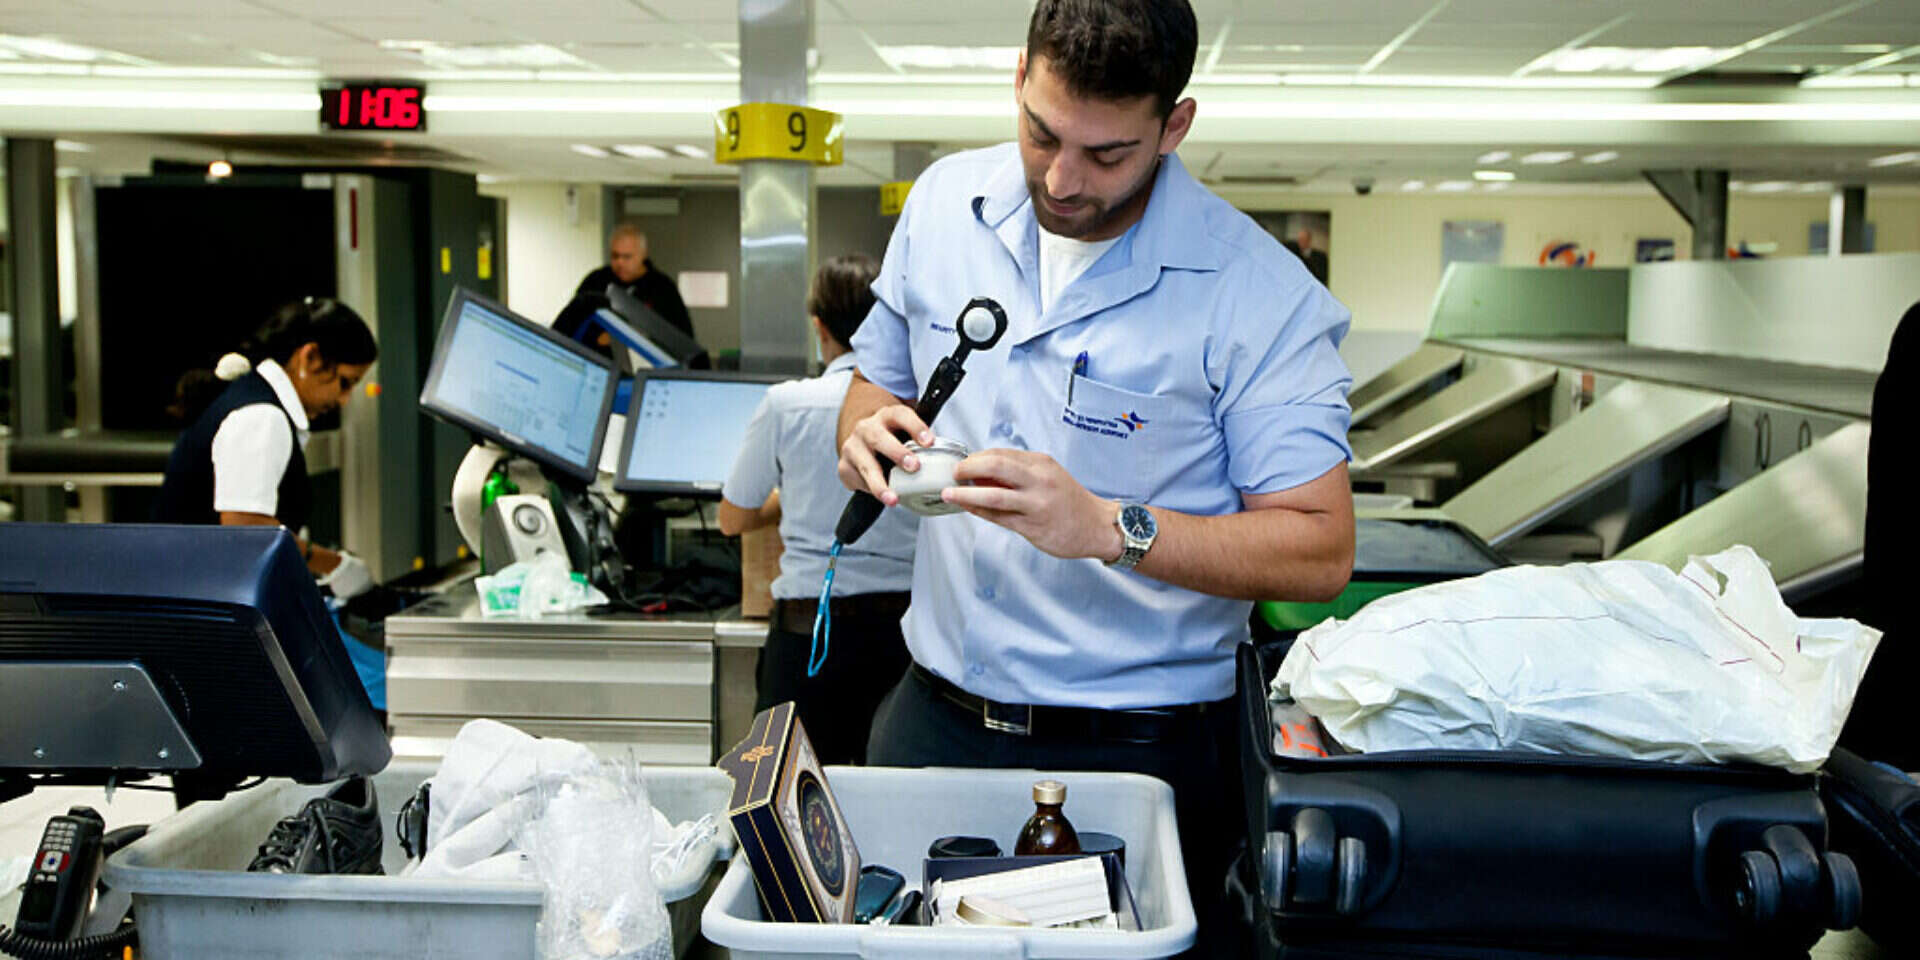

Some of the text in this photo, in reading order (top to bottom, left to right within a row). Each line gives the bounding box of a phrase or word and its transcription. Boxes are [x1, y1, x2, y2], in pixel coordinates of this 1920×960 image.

[339, 87, 419, 128] 11:06
[727, 110, 740, 152] 9
[787, 111, 807, 152] 9
